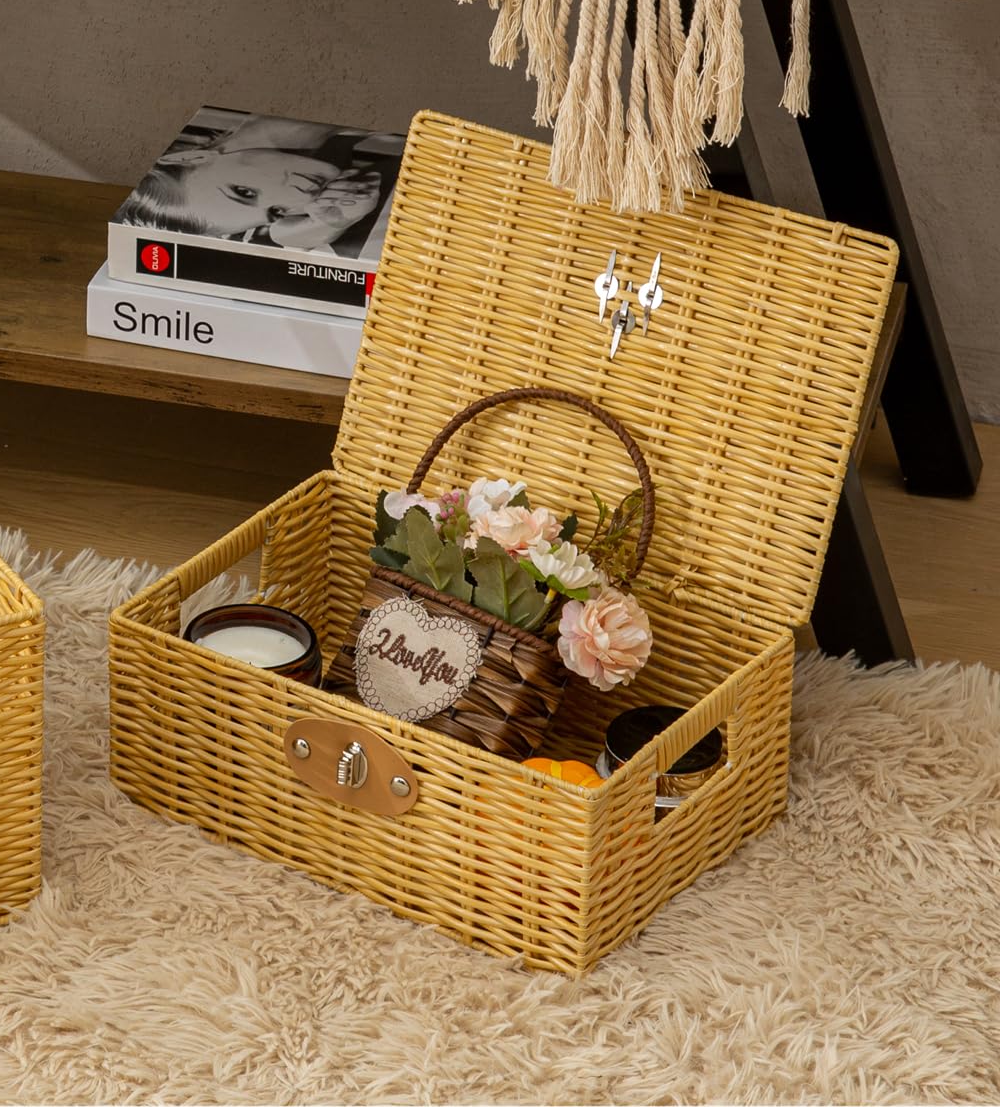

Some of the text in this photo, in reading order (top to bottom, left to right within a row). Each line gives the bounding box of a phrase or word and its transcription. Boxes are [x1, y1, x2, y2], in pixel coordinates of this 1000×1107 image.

[151, 246, 160, 270] OLIVIA
[288, 262, 366, 285] FURNITURE
[113, 301, 214, 344] Smile
